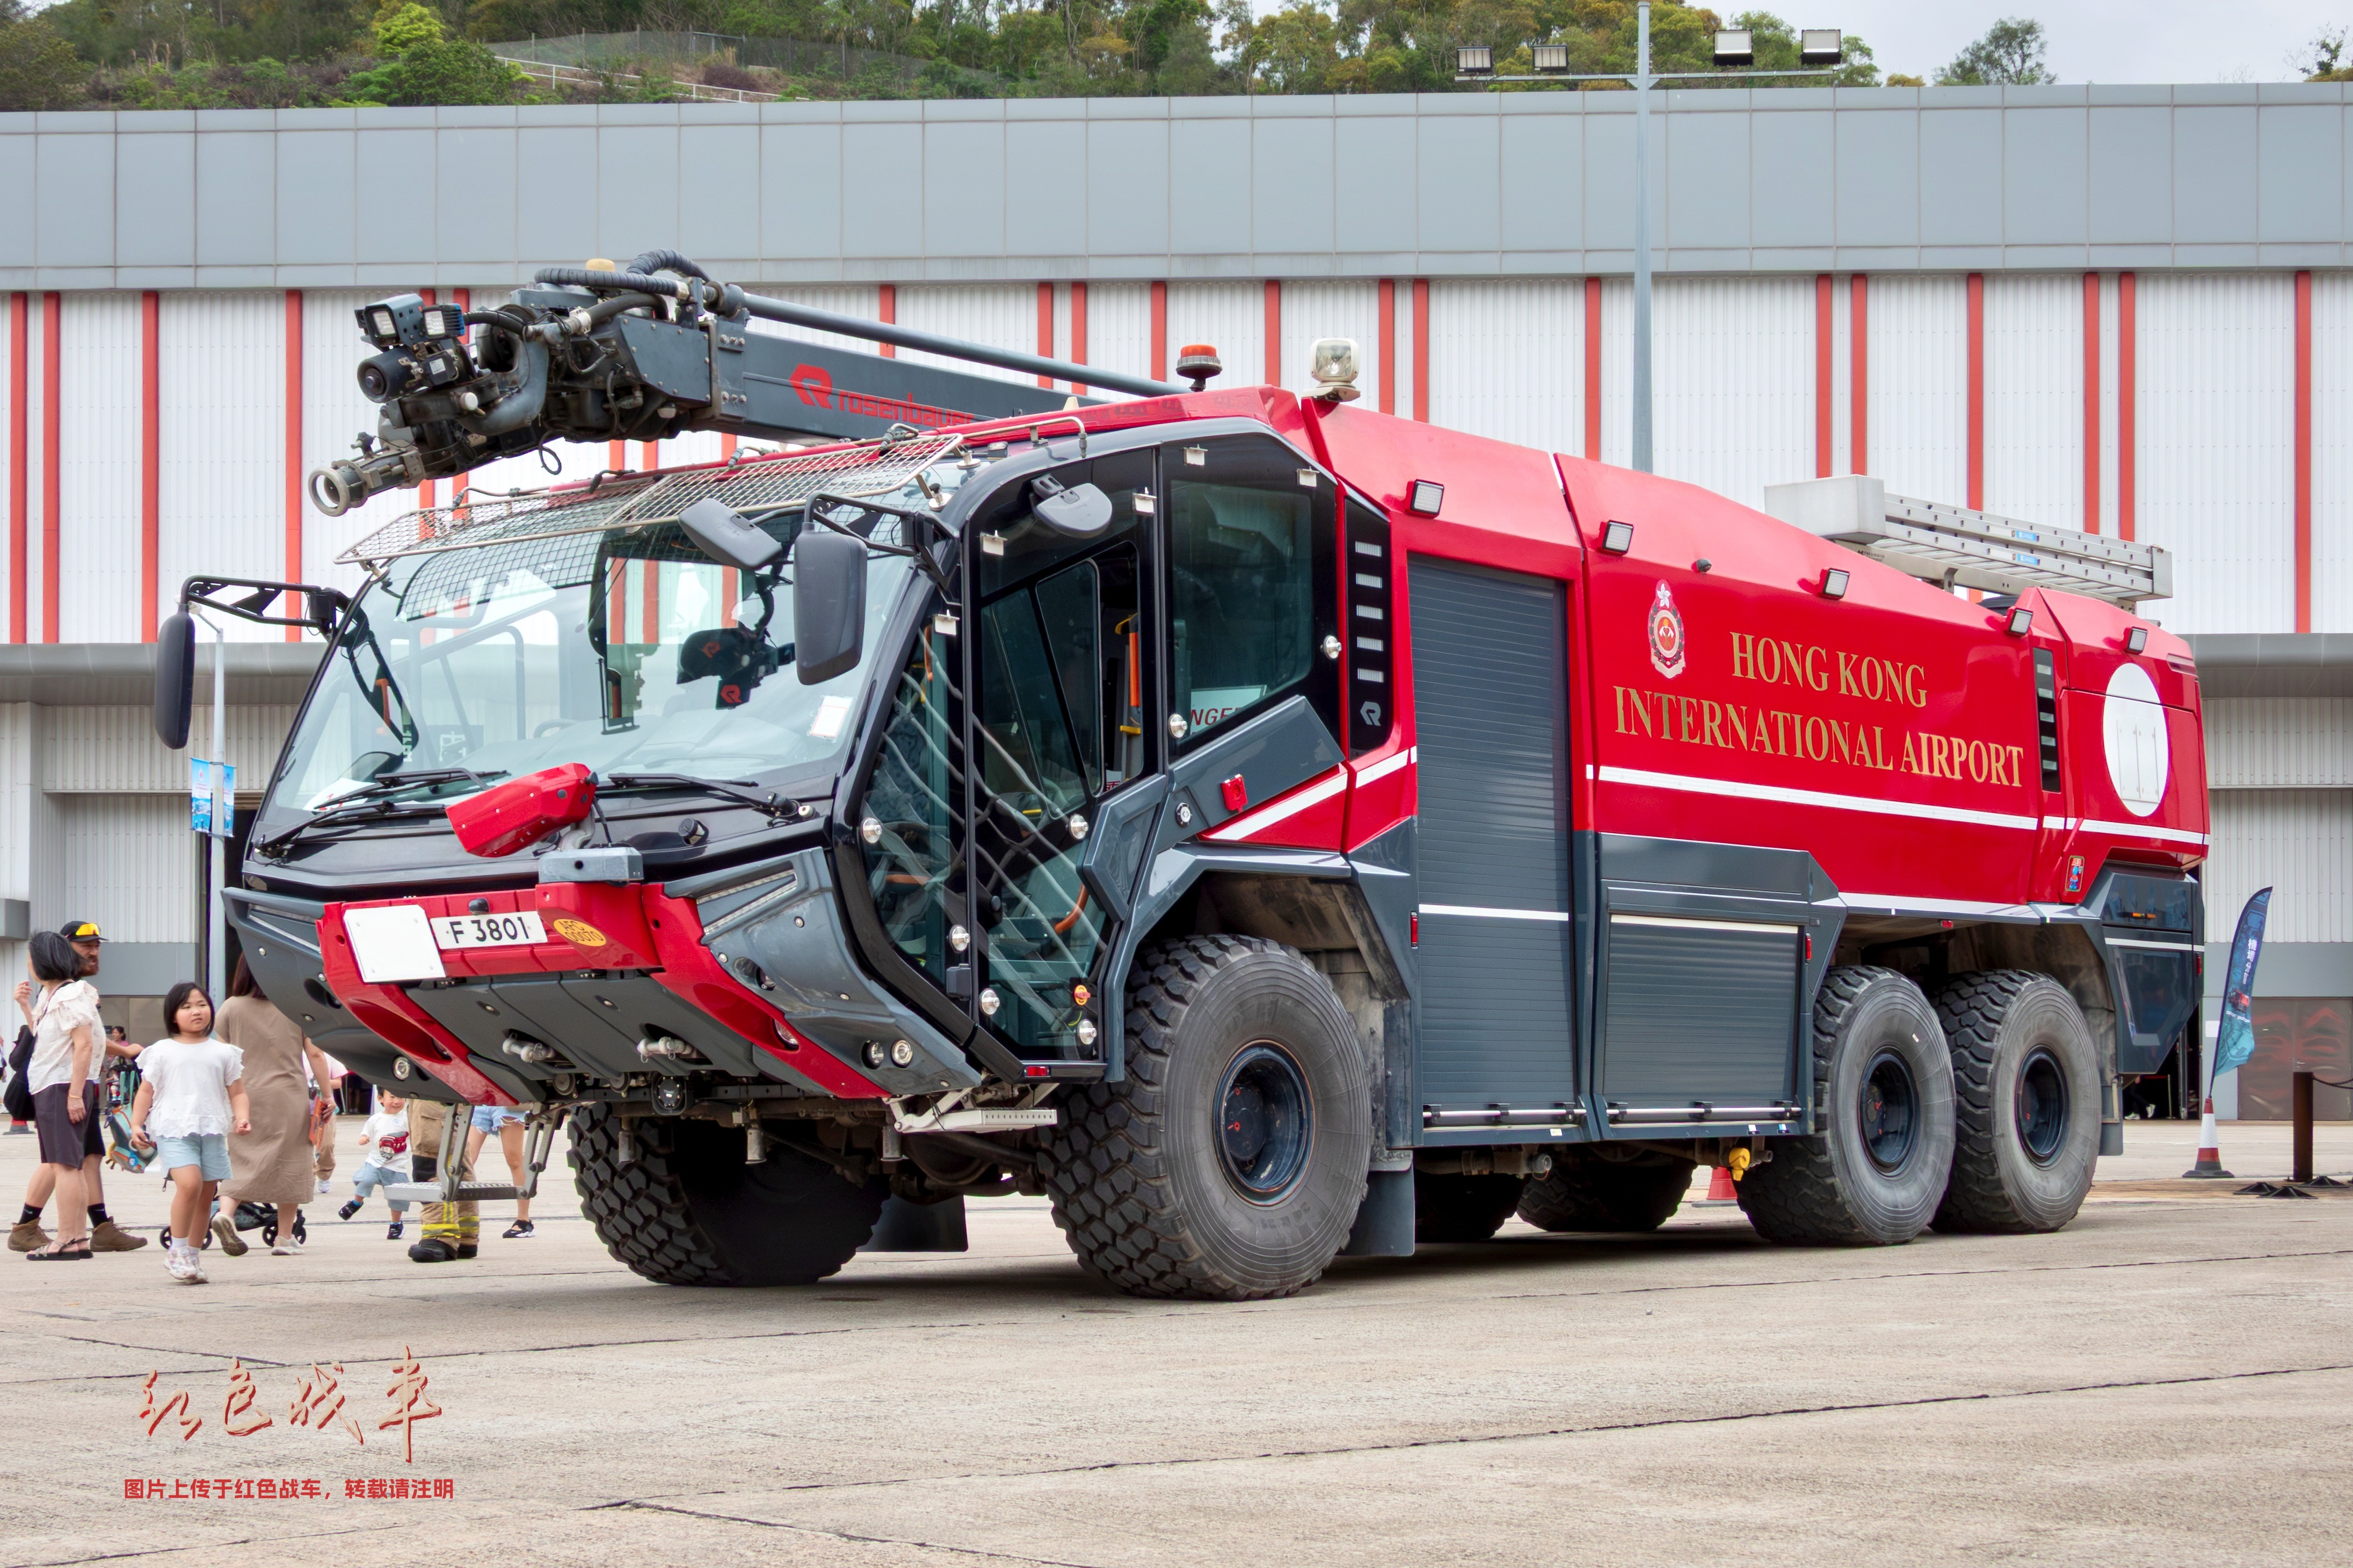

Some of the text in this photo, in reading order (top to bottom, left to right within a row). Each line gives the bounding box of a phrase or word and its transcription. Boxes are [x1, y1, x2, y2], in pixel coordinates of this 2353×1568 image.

[1730, 631, 1928, 708] HONG KONG
[1613, 685, 2024, 787] INTERNATIONAL AIRPORT
[449, 916, 530, 944] F 3801
[558, 921, 585, 931] AFC
[565, 931, 604, 942] 00070
